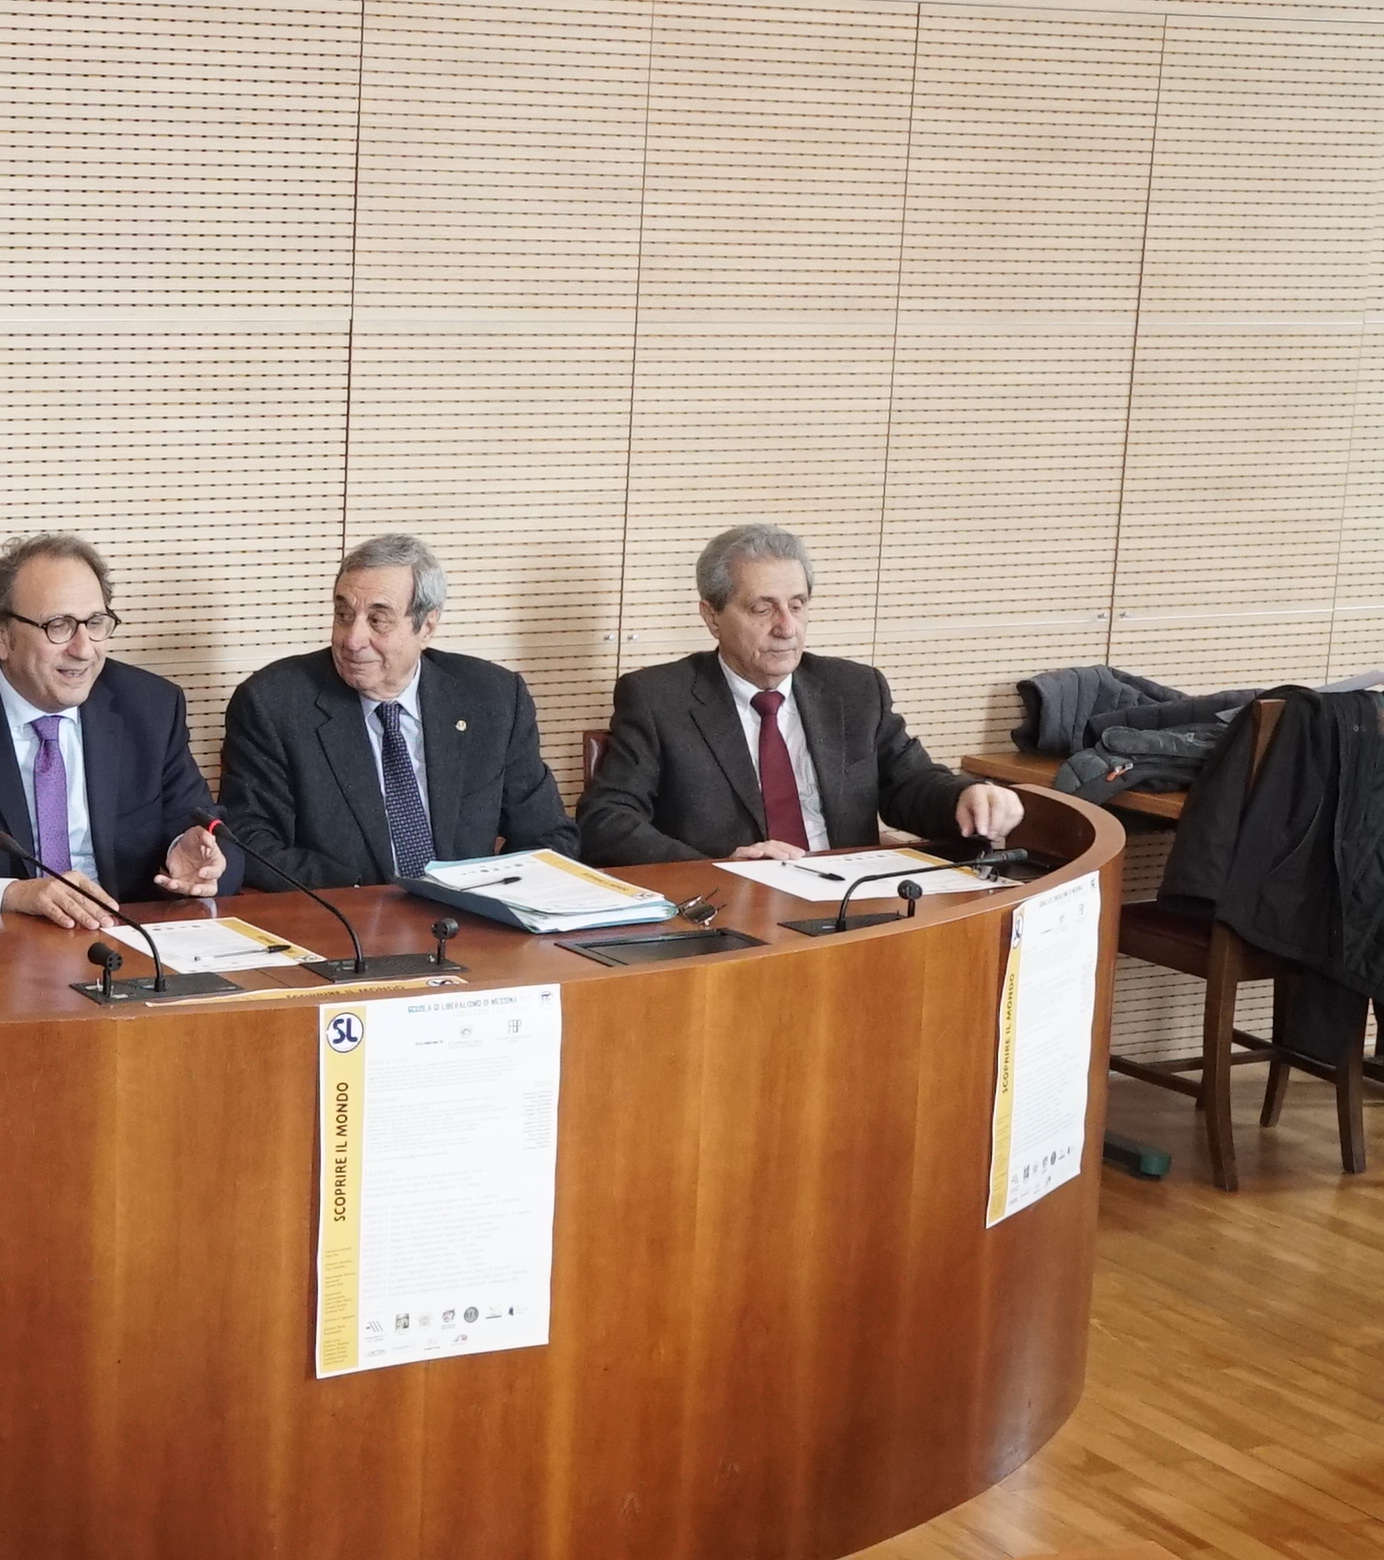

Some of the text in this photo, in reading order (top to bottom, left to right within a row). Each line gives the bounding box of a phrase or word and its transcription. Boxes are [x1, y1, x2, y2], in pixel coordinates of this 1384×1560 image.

[1006, 973, 1015, 1021] MONDO
[332, 1017, 358, 1045] SL
[333, 1082, 349, 1222] SCOPRIRE IL MONDO
